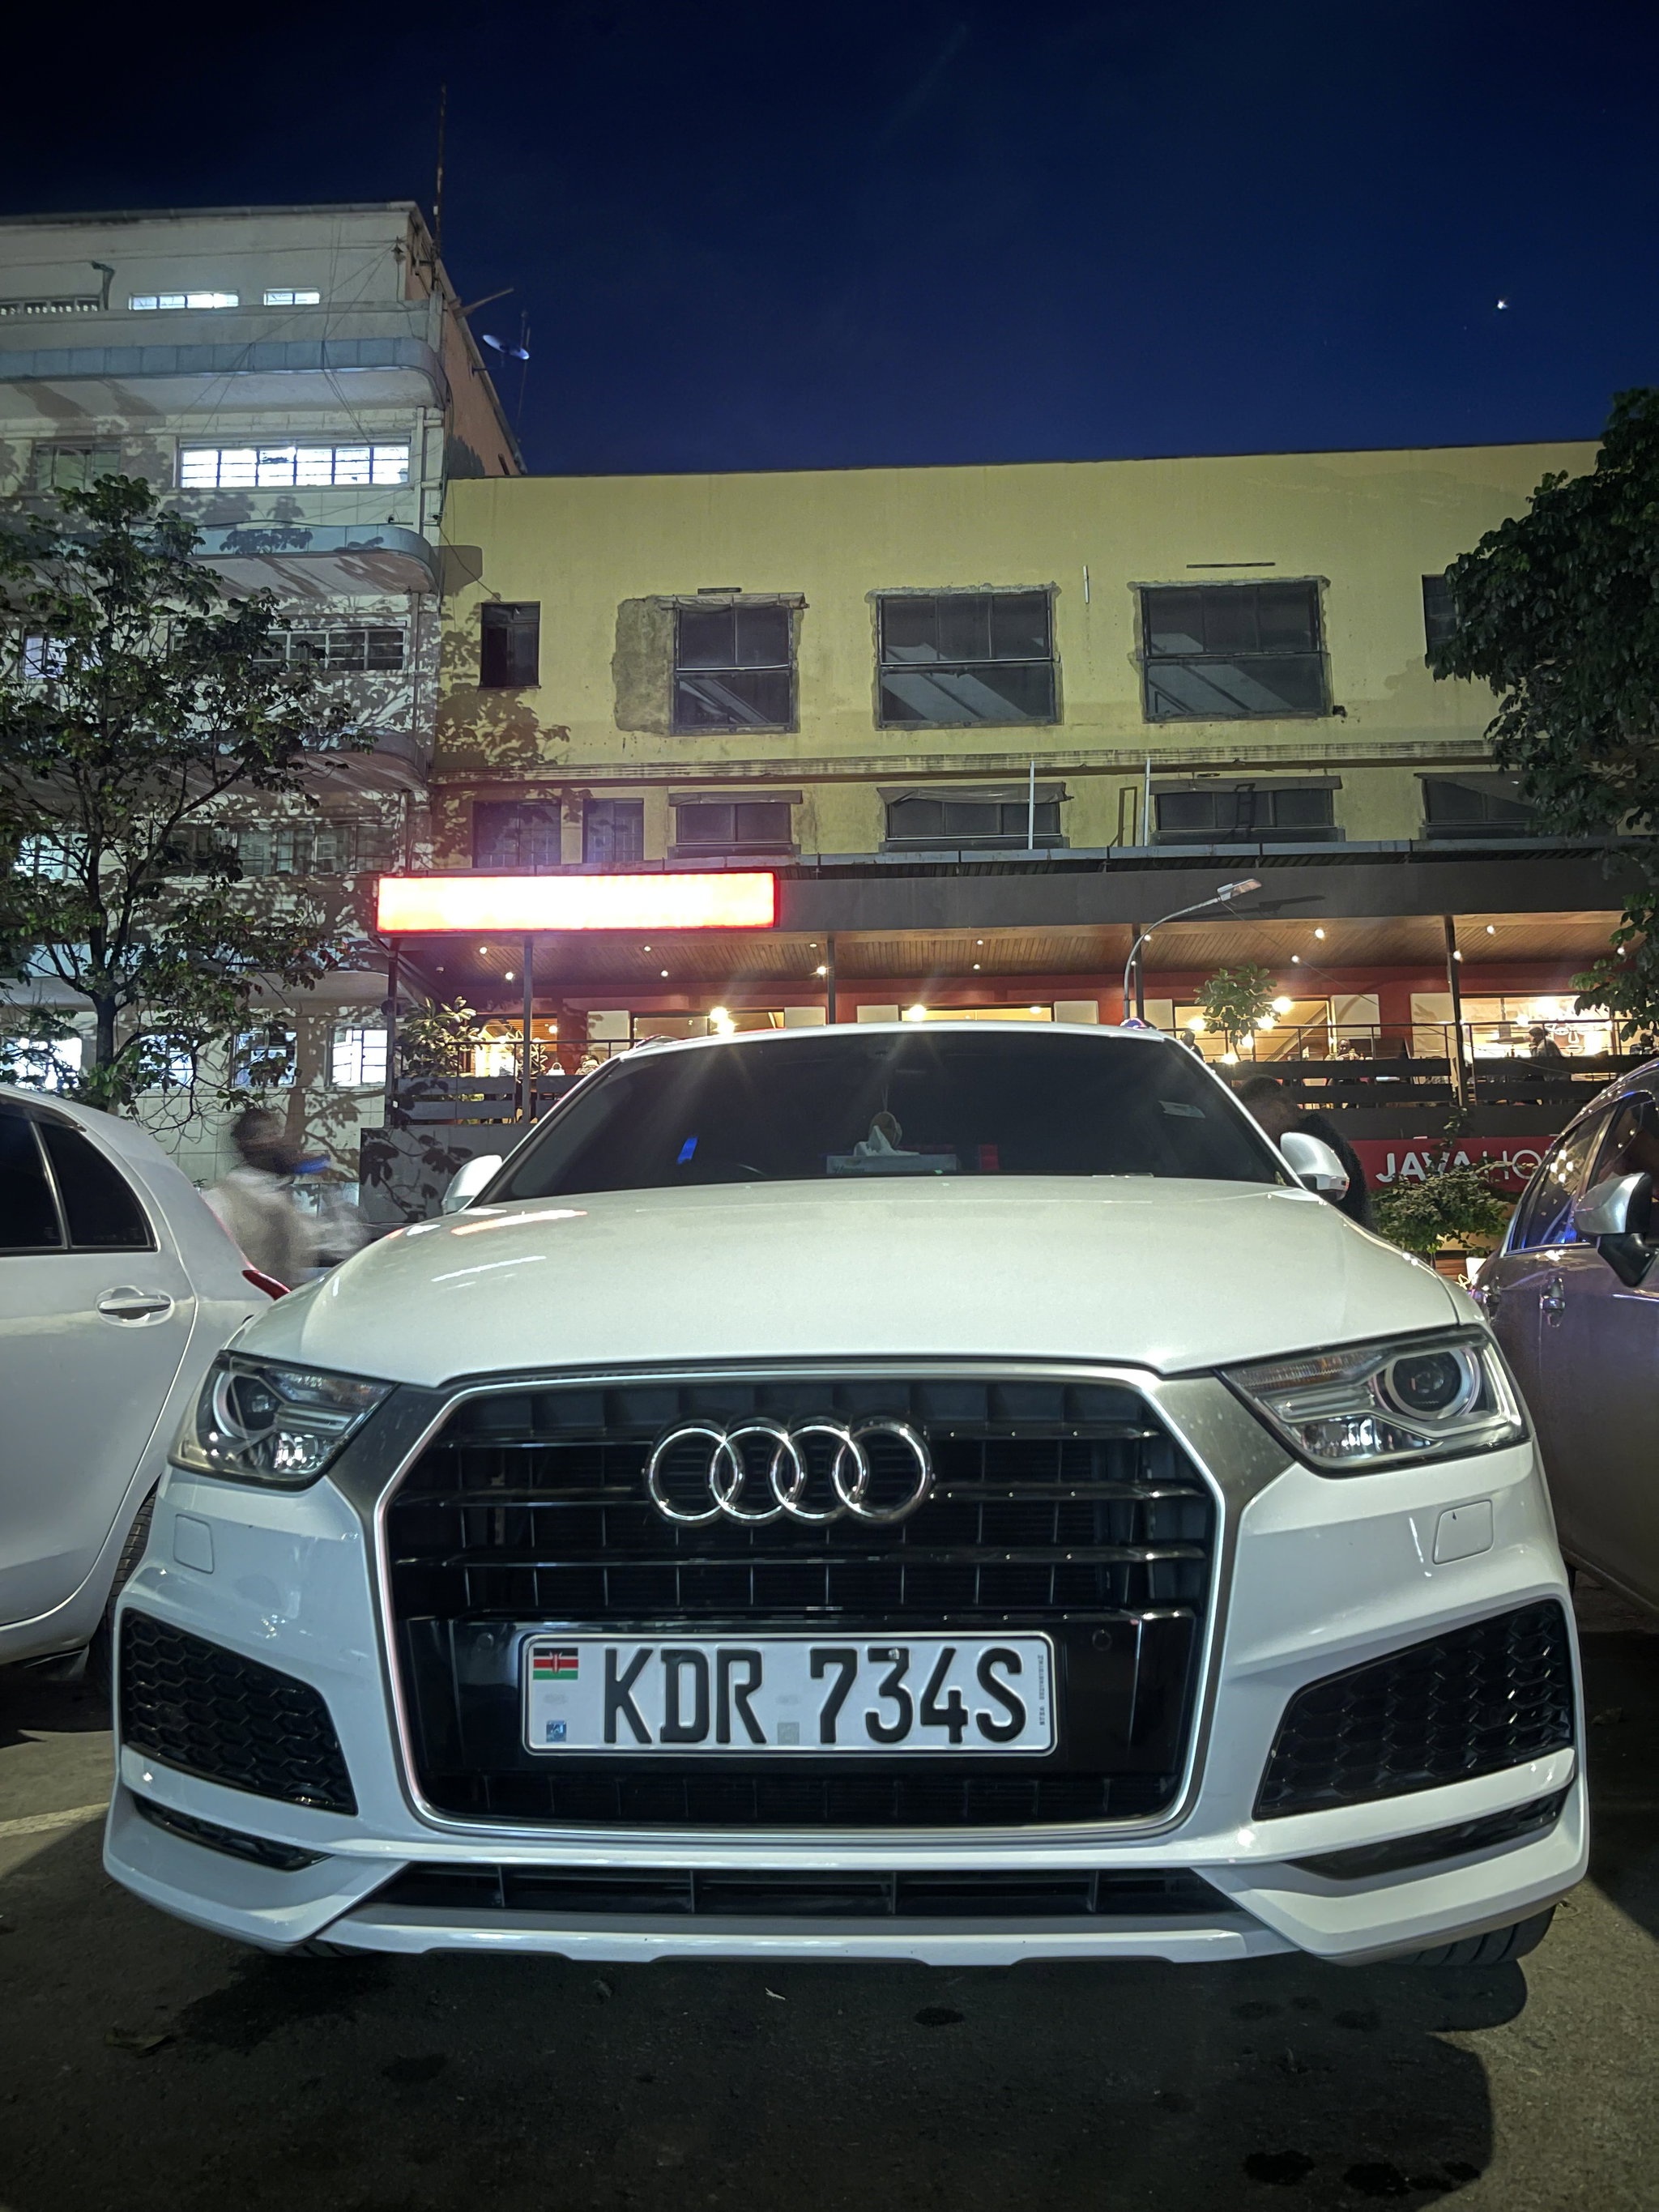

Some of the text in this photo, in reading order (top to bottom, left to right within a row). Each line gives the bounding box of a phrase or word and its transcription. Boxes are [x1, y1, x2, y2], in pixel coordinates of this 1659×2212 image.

[1482, 1149, 1550, 1180] HO
[603, 1647, 766, 1744] KDR
[810, 1647, 1026, 1743] 734S
